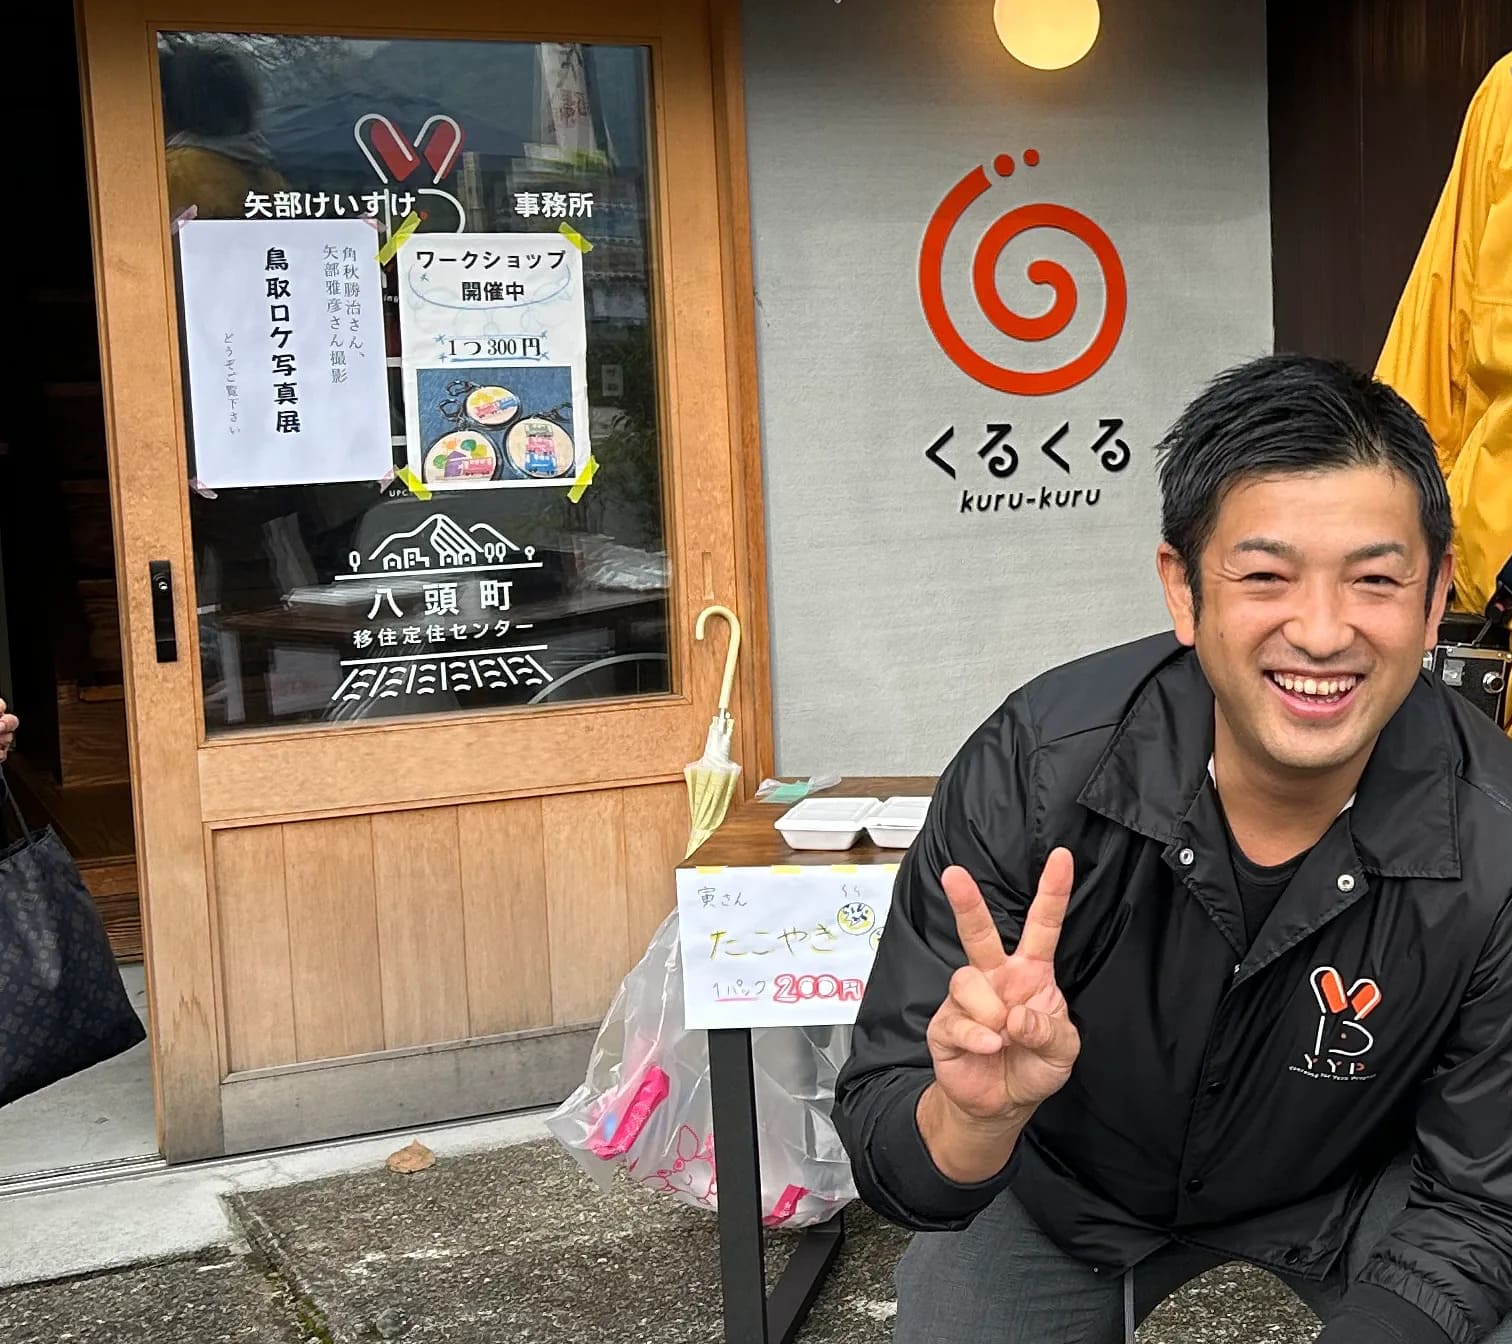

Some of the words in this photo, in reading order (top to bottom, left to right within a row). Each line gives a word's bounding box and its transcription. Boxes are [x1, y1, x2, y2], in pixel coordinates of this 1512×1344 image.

[244, 191, 416, 219] 矢部けいすけ
[514, 191, 594, 218] 事務所
[416, 249, 566, 270] ワークショップ
[462, 281, 525, 302] 開催中
[323, 244, 347, 384] 矢部雅彦さん撮影
[265, 247, 301, 434] 鳥取ロケ写真展
[223, 332, 241, 435] どうぞご覧下さい
[925, 418, 1132, 480] くるくる
[960, 486, 1101, 513] kuru-kuru
[367, 579, 513, 620] 八頭町
[352, 619, 534, 649] 移住定住センター
[710, 924, 837, 960] たこやき
[773, 973, 865, 1004] 200円
